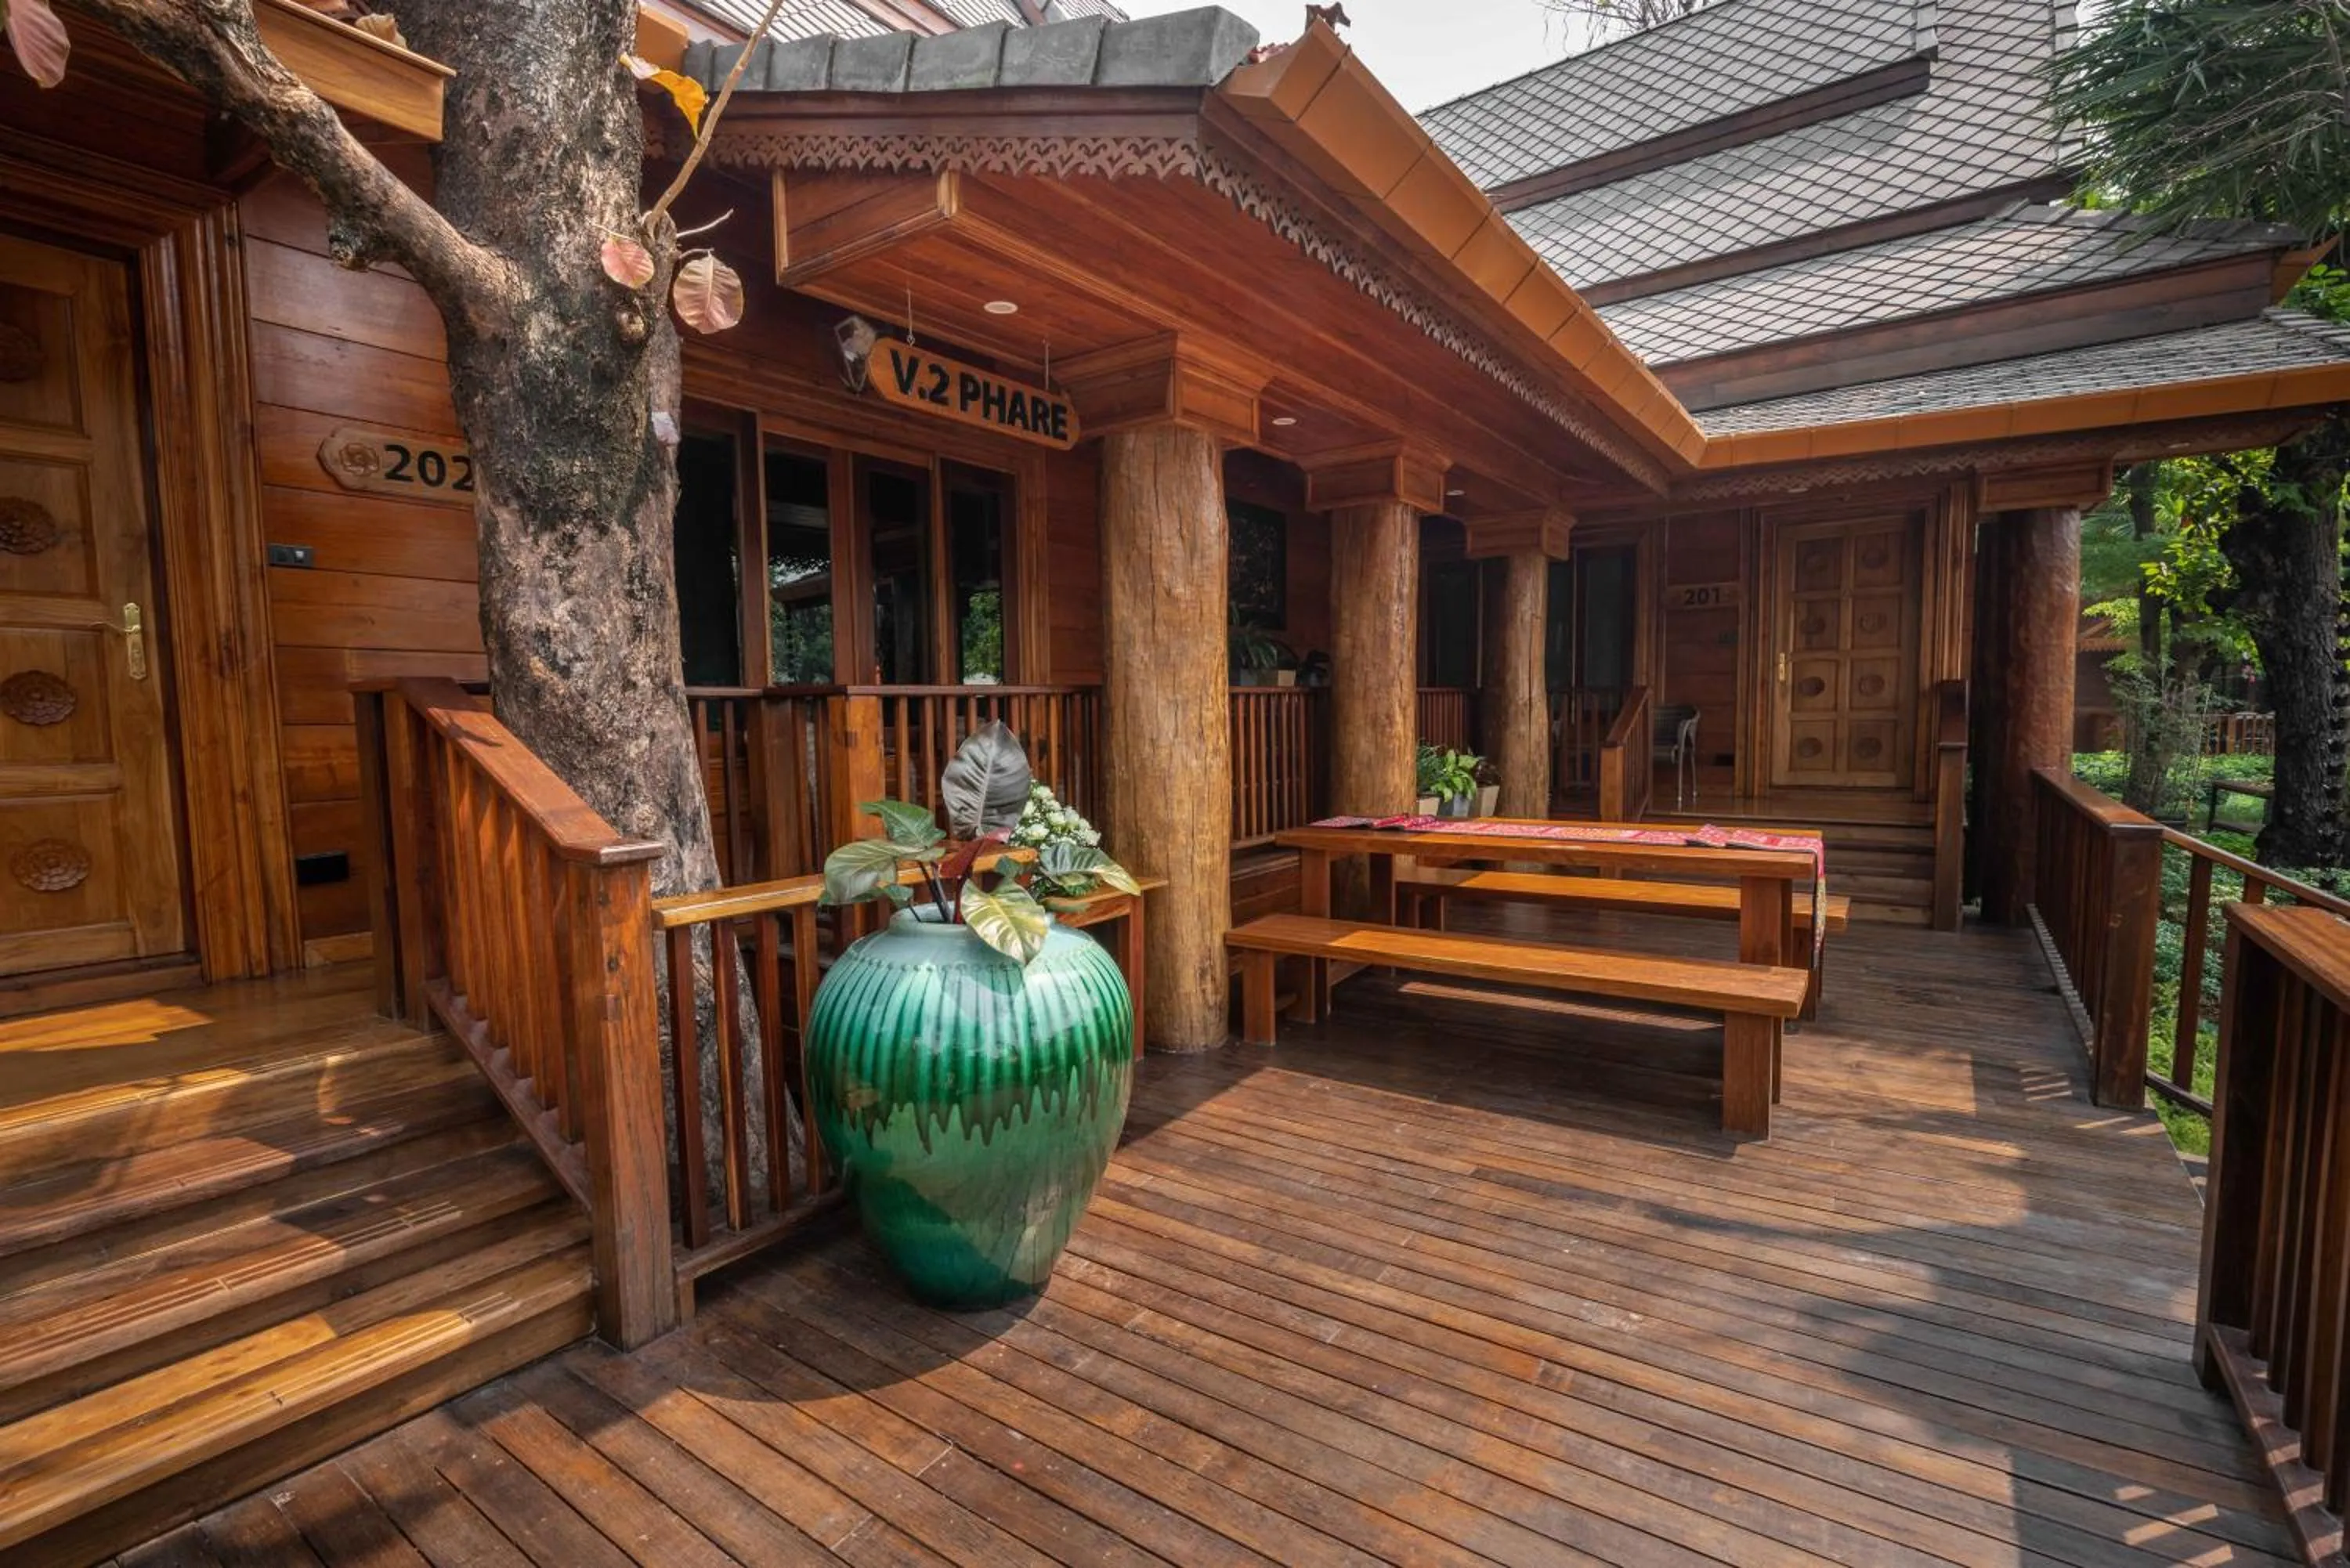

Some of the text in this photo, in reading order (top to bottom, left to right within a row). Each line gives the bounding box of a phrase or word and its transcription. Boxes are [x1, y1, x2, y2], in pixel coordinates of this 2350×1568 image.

[889, 349, 1068, 442] V.2 PHARE
[384, 444, 474, 492] 202
[1684, 587, 1720, 605] 201
